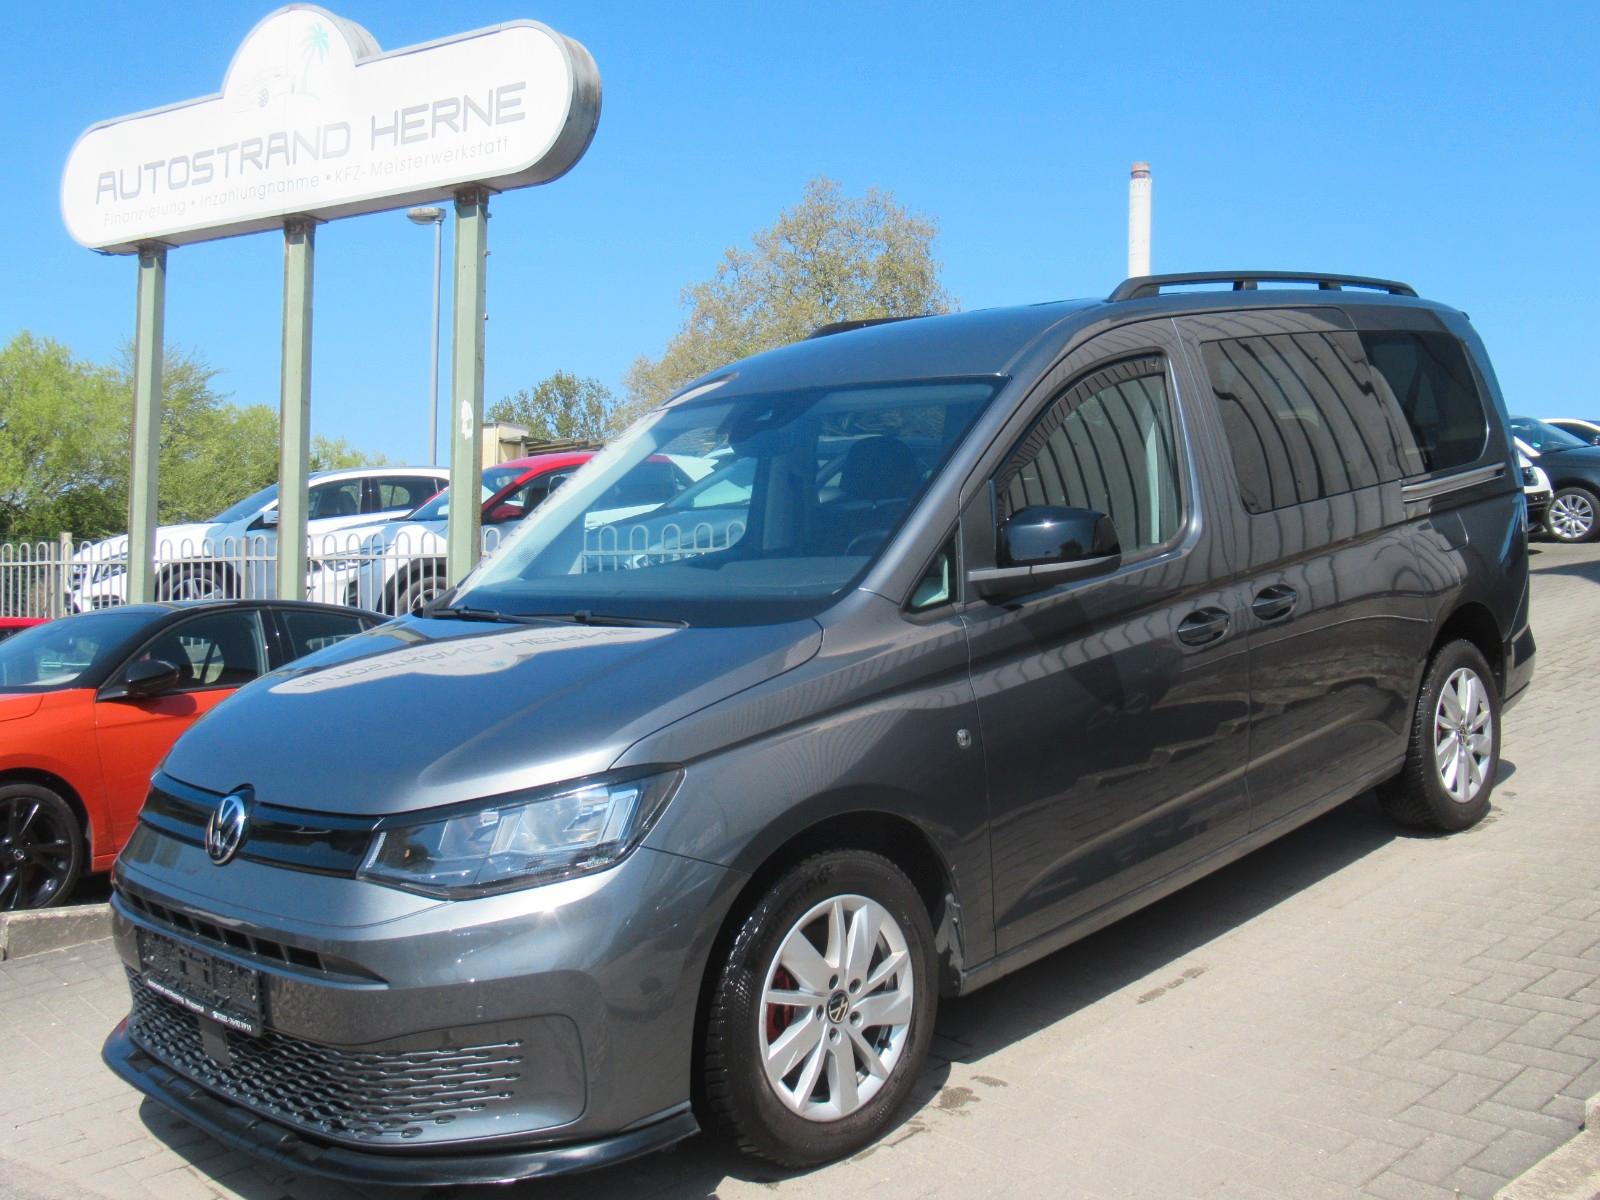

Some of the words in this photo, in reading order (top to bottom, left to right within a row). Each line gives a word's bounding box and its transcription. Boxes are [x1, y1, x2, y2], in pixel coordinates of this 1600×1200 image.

[95, 121, 350, 204] AUTOSTRAND
[371, 81, 526, 151] HERNE
[103, 200, 186, 226] Finanzierung
